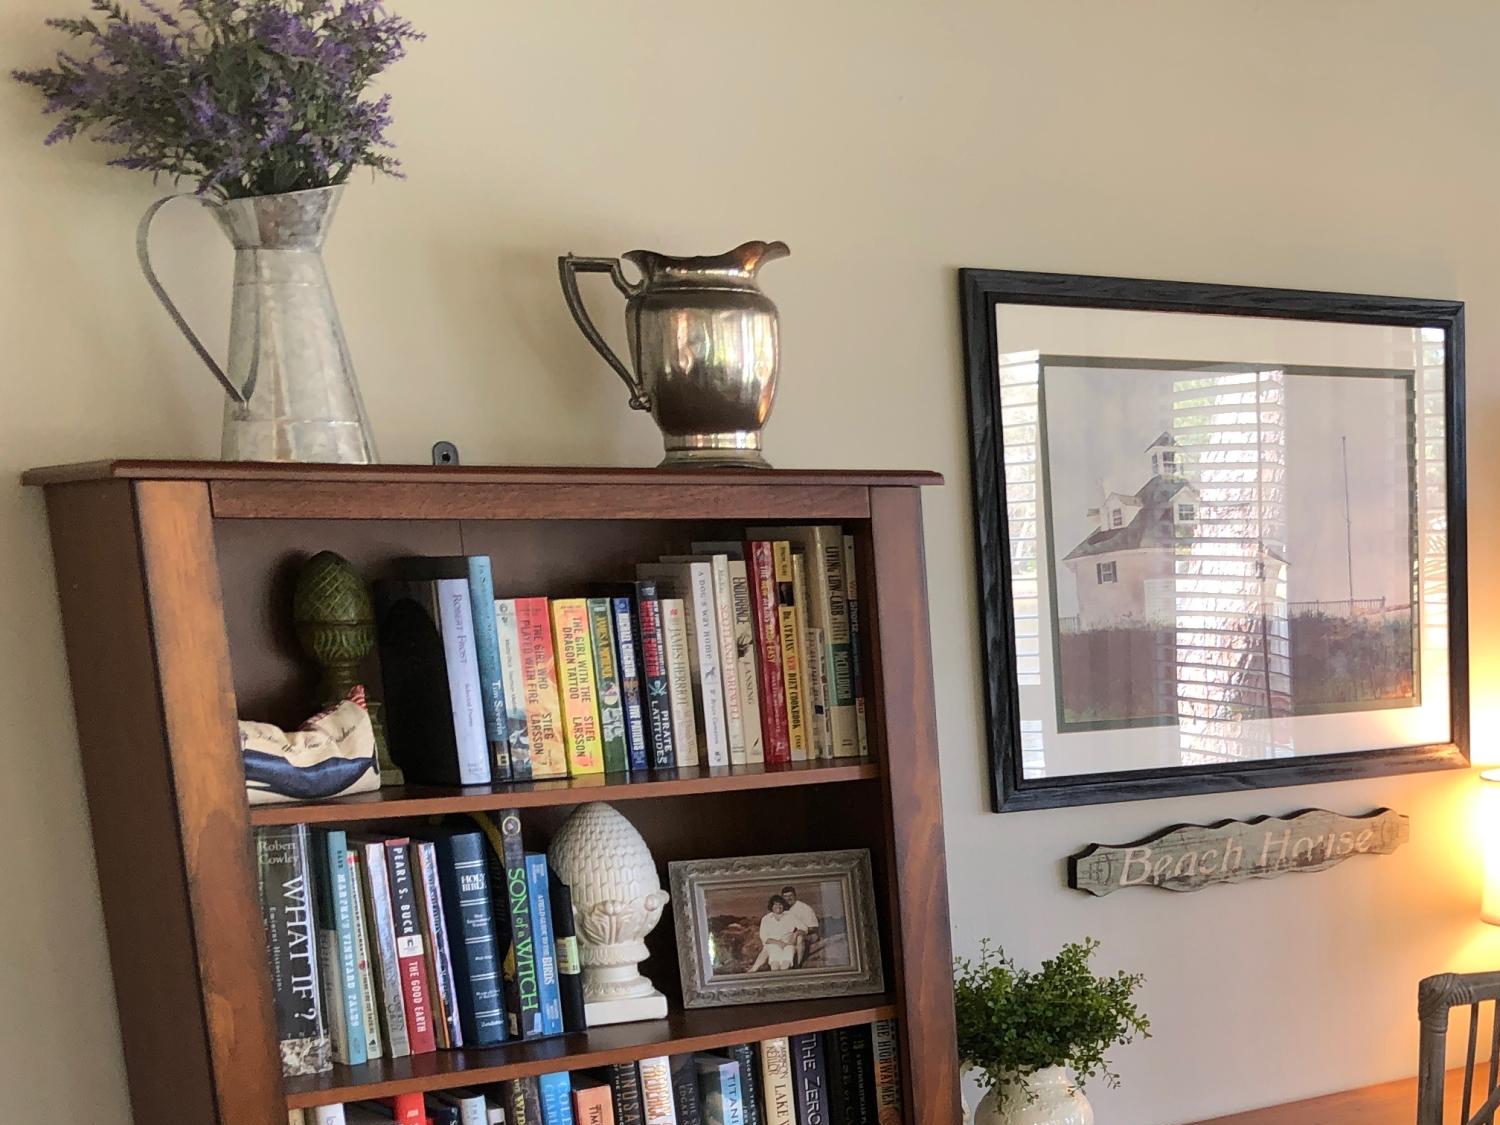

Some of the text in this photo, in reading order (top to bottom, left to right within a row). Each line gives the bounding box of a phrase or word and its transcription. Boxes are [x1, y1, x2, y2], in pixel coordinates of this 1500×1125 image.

[825, 546, 840, 572] LIVING
[732, 577, 750, 624] ENDURANCE
[760, 566, 769, 578] THE
[767, 646, 776, 663] EASY
[828, 574, 844, 616] LOW-CARB
[521, 620, 532, 654] PLAYED
[668, 627, 681, 665] JAMES
[720, 604, 733, 665] SCOTLAND
[525, 657, 536, 681] WITH
[534, 624, 548, 690] THE GIRL WHO
[563, 627, 579, 700] DRAGON TATTOO
[573, 616, 591, 702] THE GIRL WITH THE
[528, 683, 539, 705] FIRE
[672, 669, 686, 706] HERRIOT
[726, 667, 740, 721] FAREWELL
[743, 660, 754, 705] LANSING
[788, 673, 798, 690] DIET
[492, 680, 504, 735] Tim Severin
[542, 712, 553, 740] STIEG
[530, 714, 544, 755] LARSSON
[573, 717, 586, 757] LARSSON
[584, 715, 595, 742] STIEG
[651, 701, 665, 764] LATITUDES
[661, 710, 672, 752] PIRATE
[260, 840, 297, 854] Robert
[260, 854, 300, 869] Cowley
[1119, 828, 1376, 886] Beach House
[393, 847, 413, 934] PEARL S. BUCK
[461, 872, 485, 883] HOLY
[281, 875, 312, 965] WHAT
[508, 867, 539, 1011] SON of WITCH
[343, 934, 356, 989] VINEYARD
[542, 957, 554, 985] BIRDS
[349, 994, 359, 1027] TALES
[409, 961, 427, 1032] THE GOOD EARTH
[801, 1034, 818, 1072] THE
[876, 1019, 896, 1107] THE HIGHWAYMEN
[642, 1065, 671, 1120] FREDERICK
[679, 1085, 689, 1116] EDGAR
[687, 1083, 694, 1095] IN
[689, 1098, 697, 1116] THE
[774, 1083, 789, 1117] LAKE
[804, 1076, 822, 1125] ZERO
